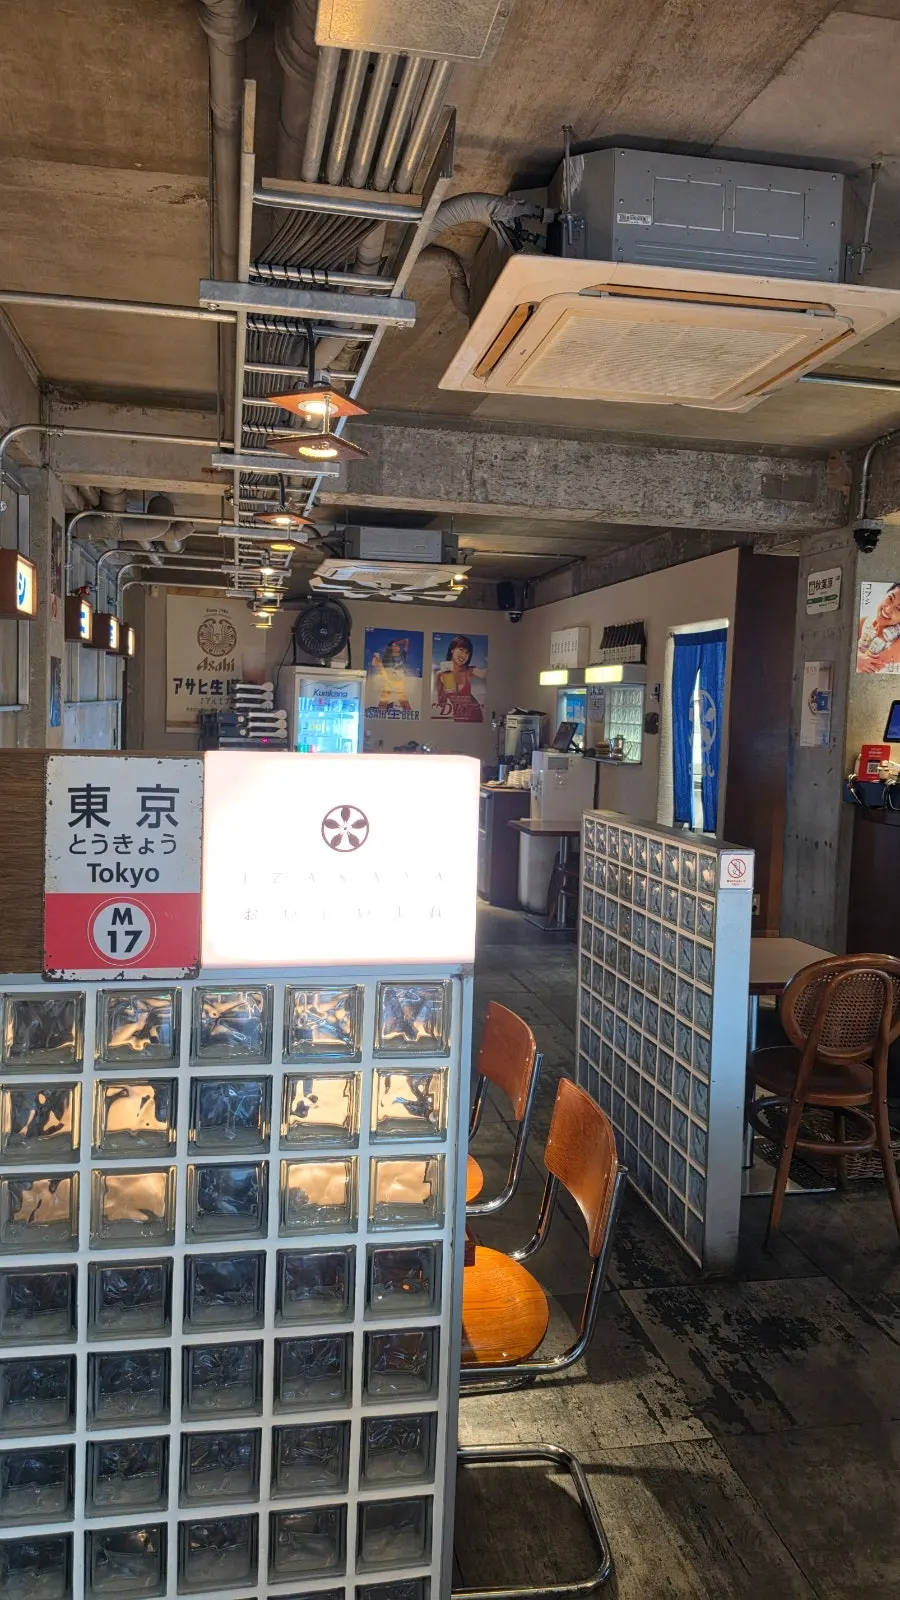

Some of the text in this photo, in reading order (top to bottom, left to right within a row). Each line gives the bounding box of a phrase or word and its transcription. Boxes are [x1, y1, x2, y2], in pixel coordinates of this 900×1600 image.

[196, 656, 235, 672] Asahi
[68, 783, 180, 829] 東京
[69, 834, 177, 855] とうきょう
[87, 862, 160, 888] Tokyo
[112, 907, 133, 926] M
[107, 930, 143, 954] 17
